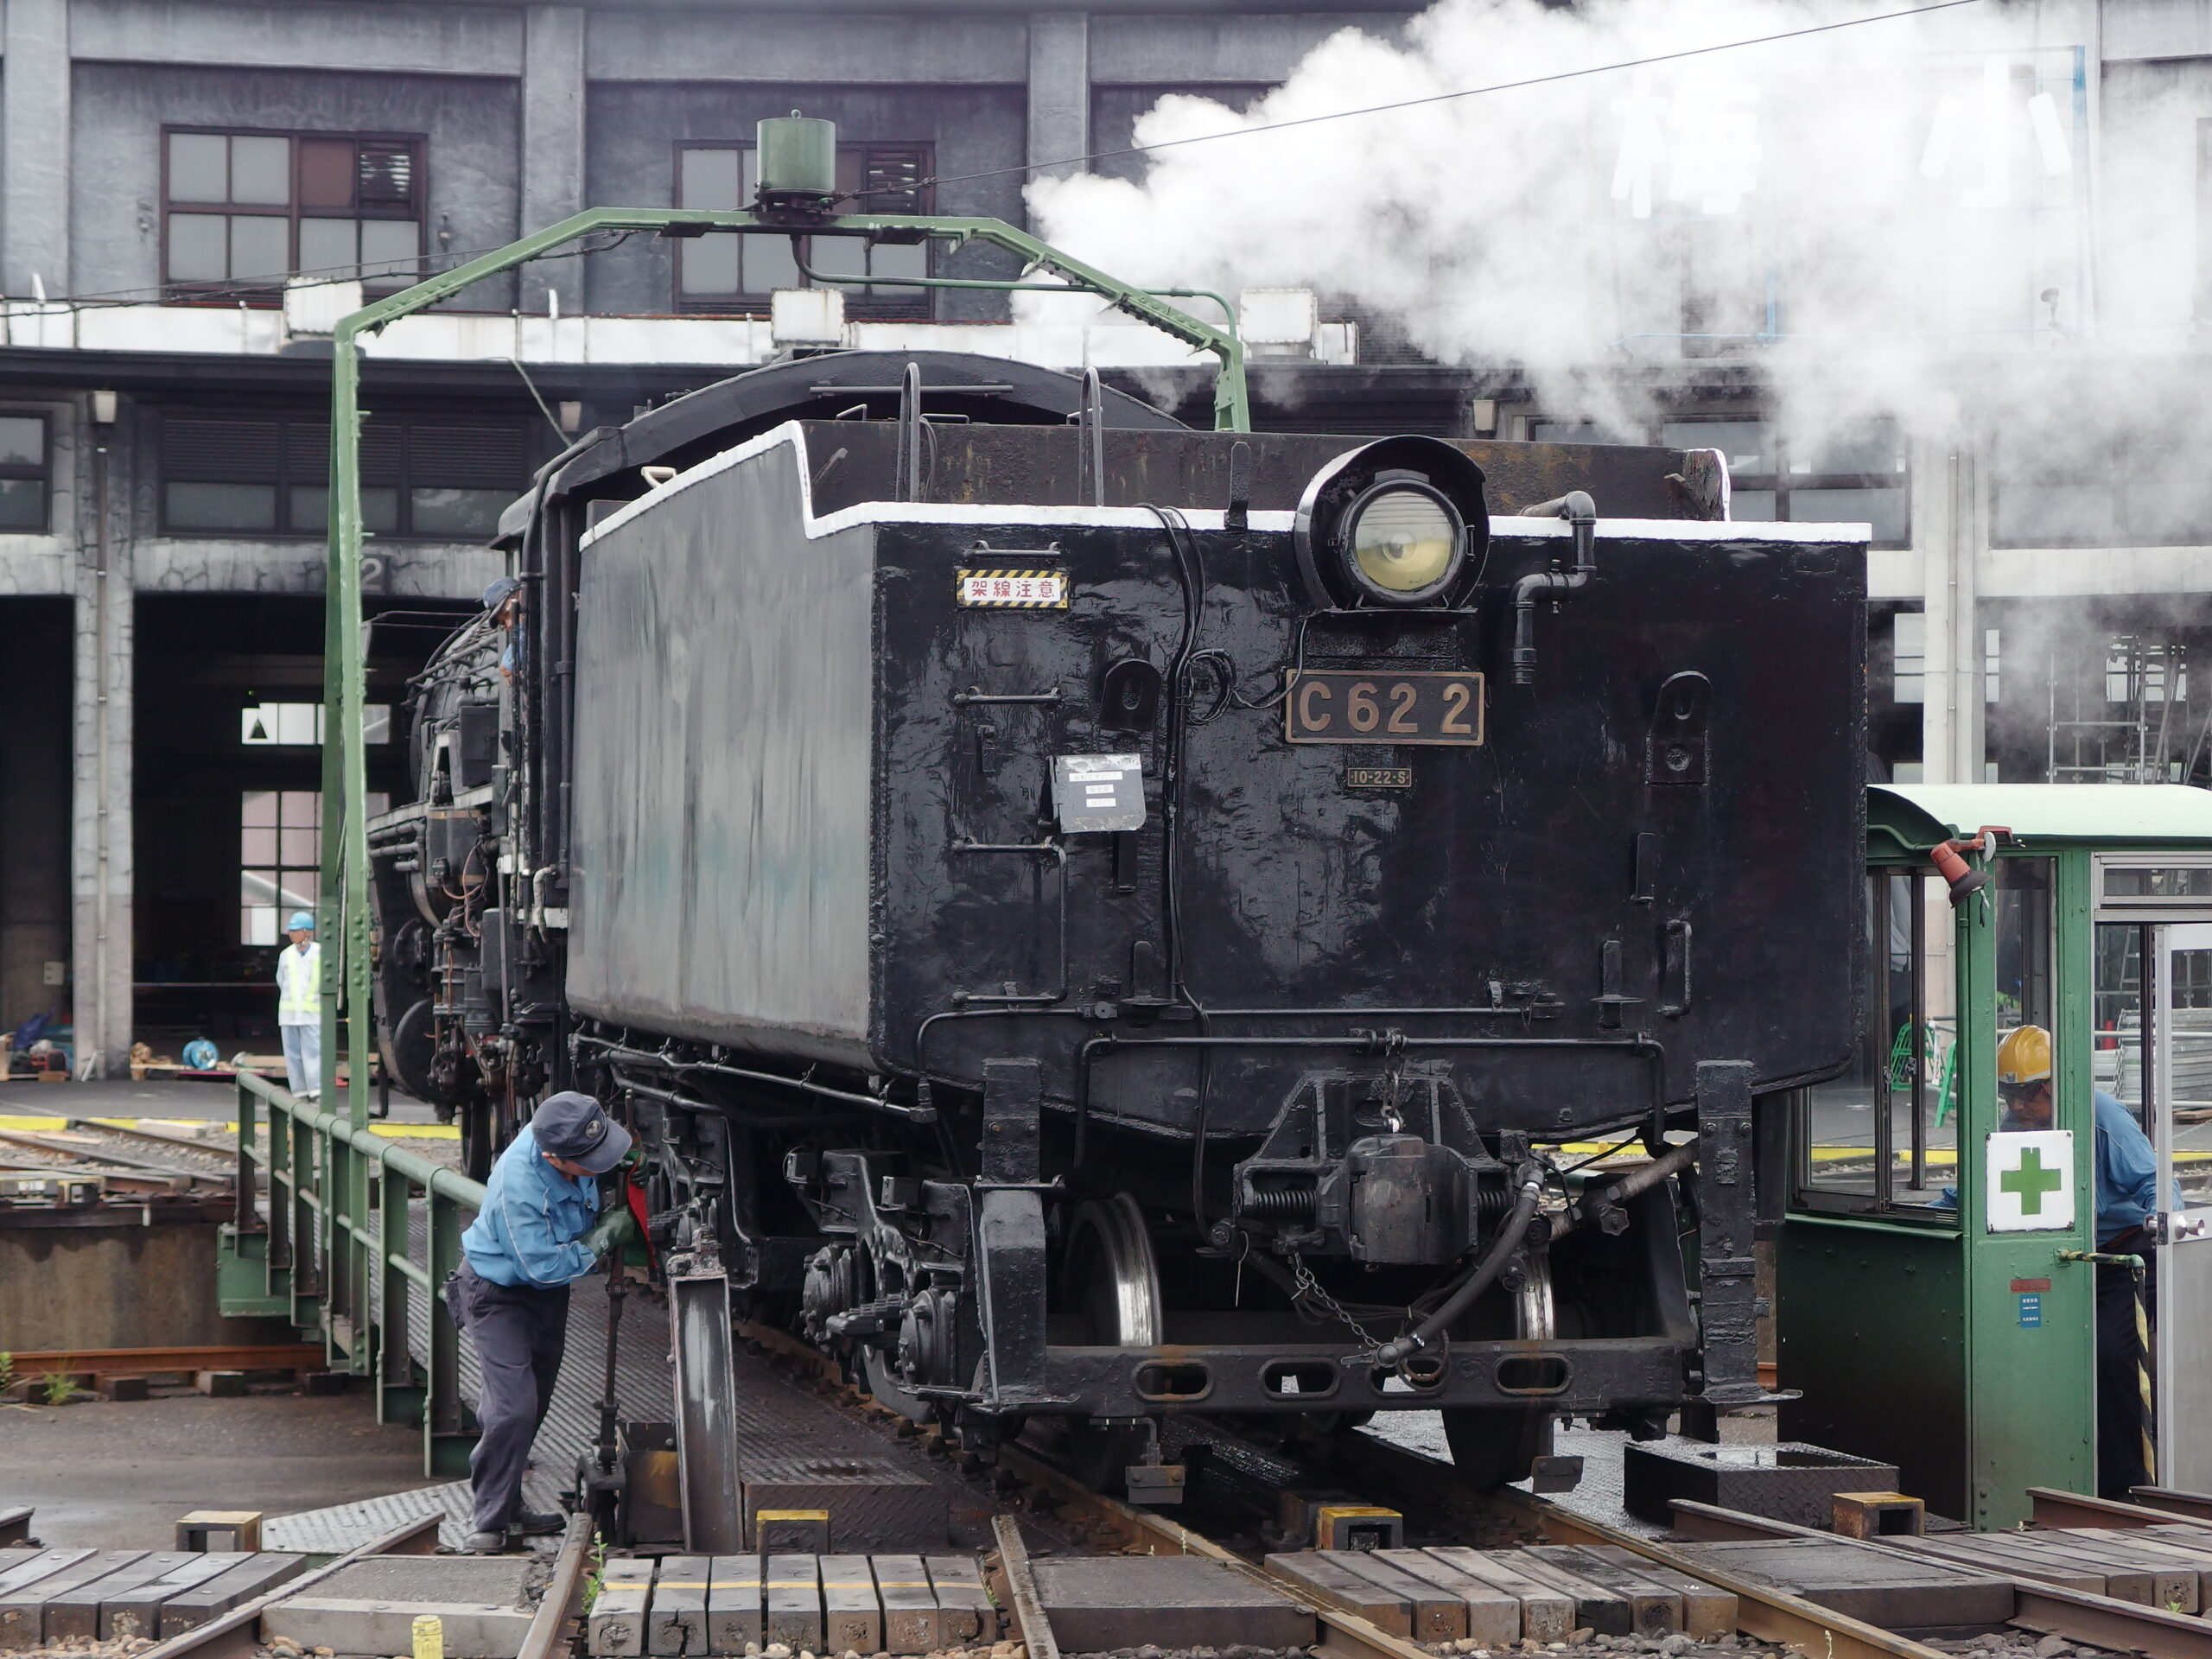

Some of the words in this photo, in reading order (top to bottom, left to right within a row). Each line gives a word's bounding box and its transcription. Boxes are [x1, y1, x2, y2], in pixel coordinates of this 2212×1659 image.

[971, 580, 1055, 598] 架線注意
[1440, 683, 1472, 734] 2
